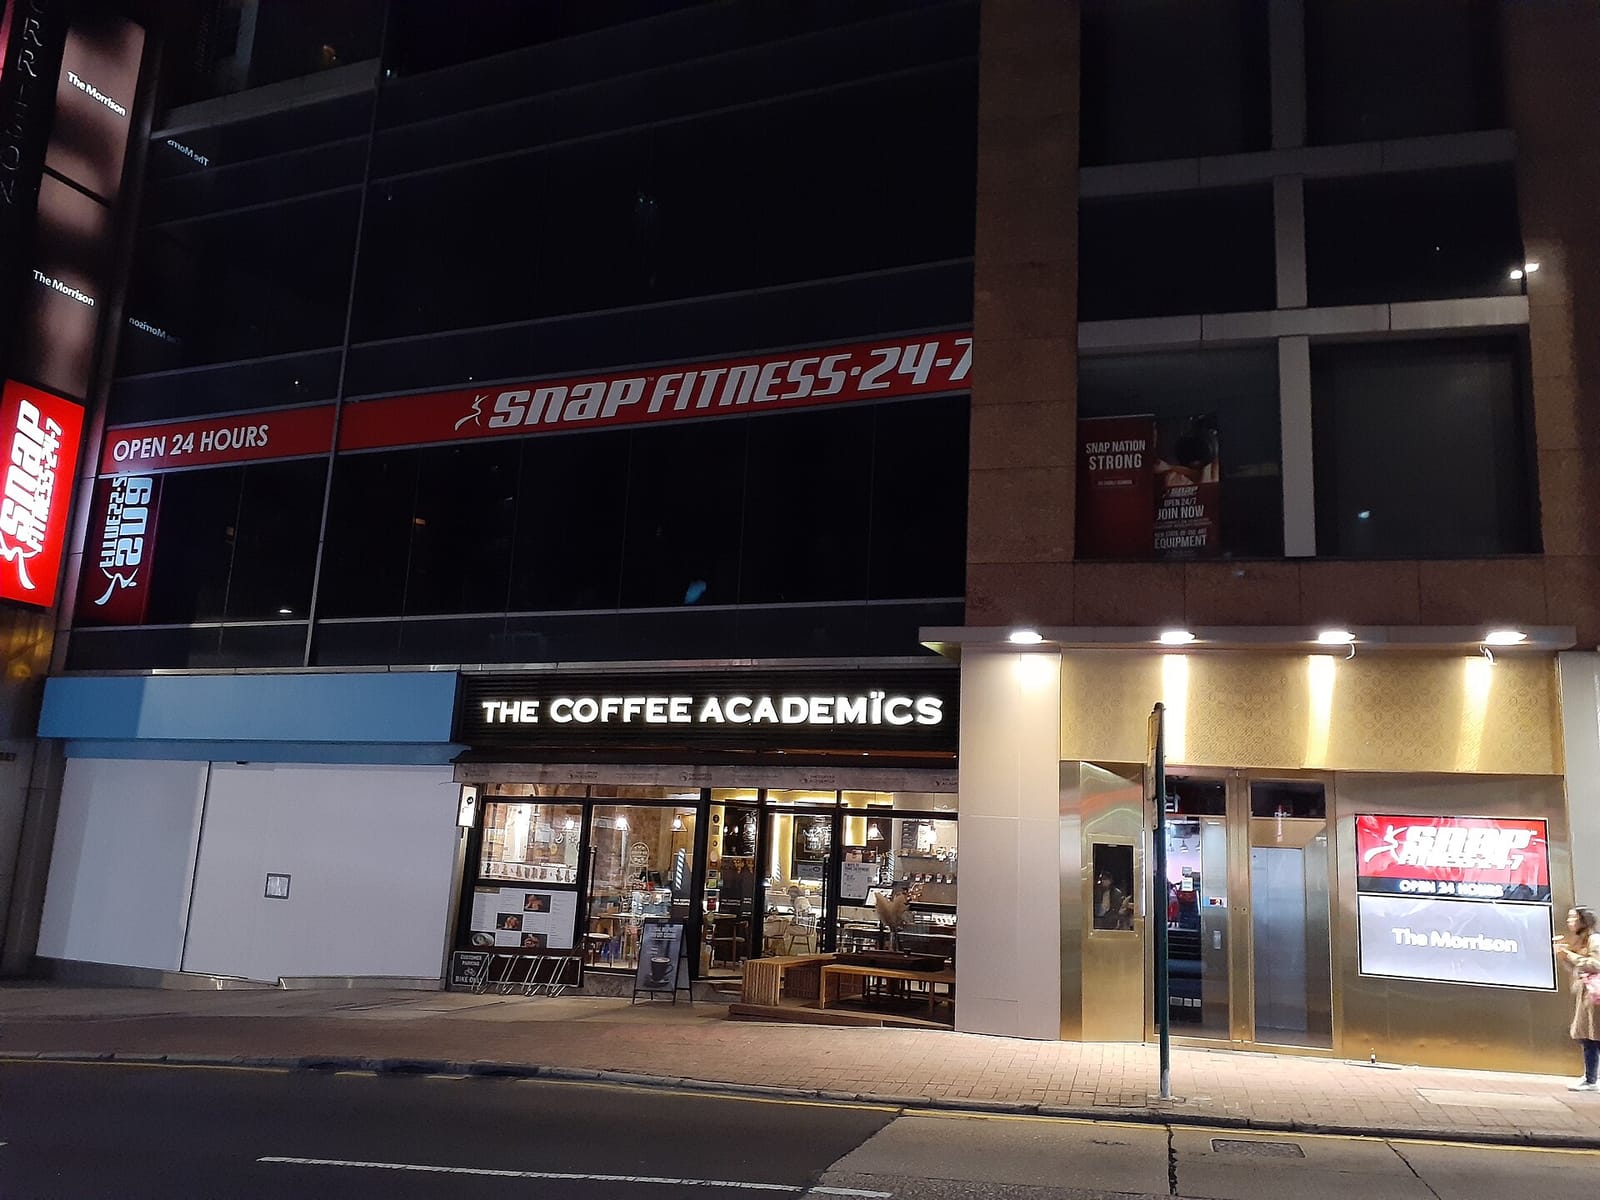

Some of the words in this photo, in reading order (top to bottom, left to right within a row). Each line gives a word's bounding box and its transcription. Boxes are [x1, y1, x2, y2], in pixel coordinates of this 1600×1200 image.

[67, 71, 86, 94] The
[85, 83, 127, 117] Morrison
[32, 269, 52, 287] The
[51, 279, 95, 307] Morrison
[113, 436, 167, 462] OPEN
[169, 432, 195, 456] 24
[199, 424, 269, 453] HOURS
[1085, 441, 1111, 455] SNAP
[1111, 439, 1146, 453] NATION
[1088, 454, 1143, 471] STRONG
[1164, 499, 1180, 508] OPEN
[1156, 506, 1179, 521] JOIN
[1180, 505, 1205, 519] NOW
[1154, 534, 1207, 550] EQUIPMENT
[482, 700, 540, 724] THE
[550, 696, 693, 724] COFFEE
[1399, 879, 1436, 894] OPEN
[1437, 881, 1456, 895] 24
[1391, 927, 1428, 947] The
[1430, 930, 1519, 953] Morrison
